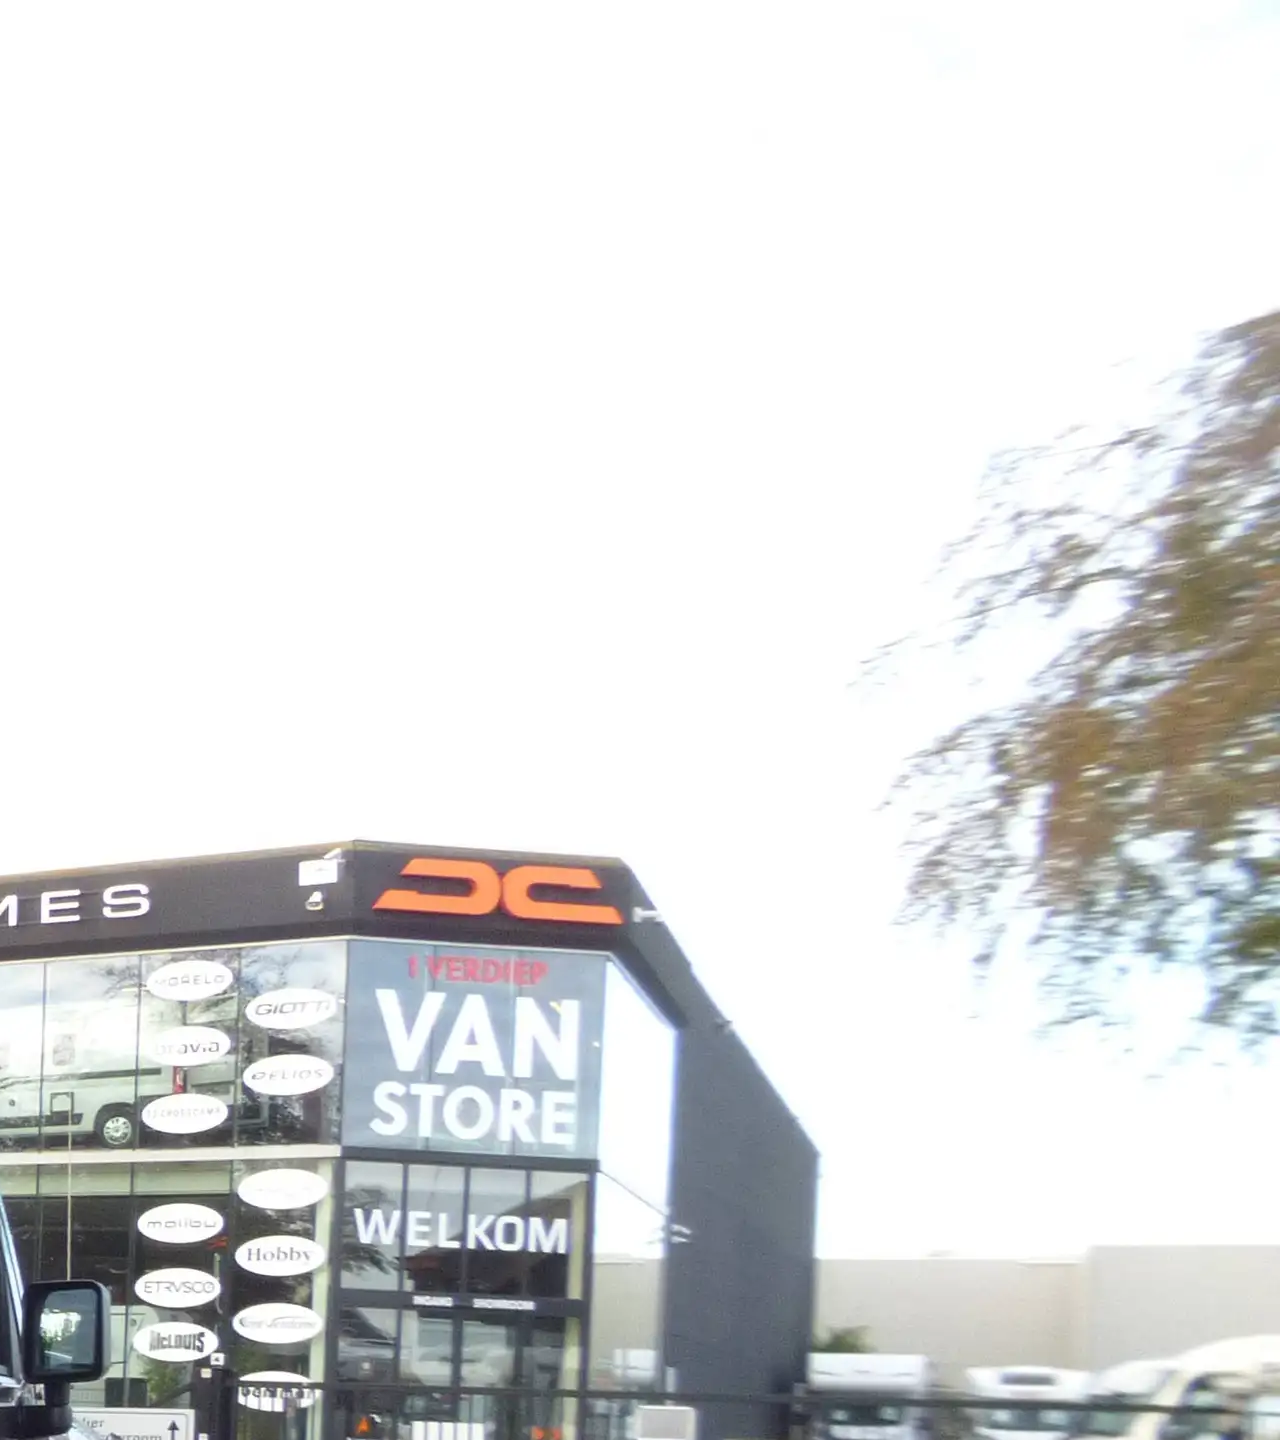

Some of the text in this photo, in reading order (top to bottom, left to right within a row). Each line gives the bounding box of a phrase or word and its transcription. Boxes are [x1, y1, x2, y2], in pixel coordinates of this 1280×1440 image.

[426, 955, 550, 986] VERDIEP
[375, 988, 580, 1081] VAN
[369, 1081, 576, 1145] STORE
[146, 1217, 217, 1229] malibu
[353, 1207, 569, 1254] WELKOM
[246, 1247, 314, 1268] Hobby
